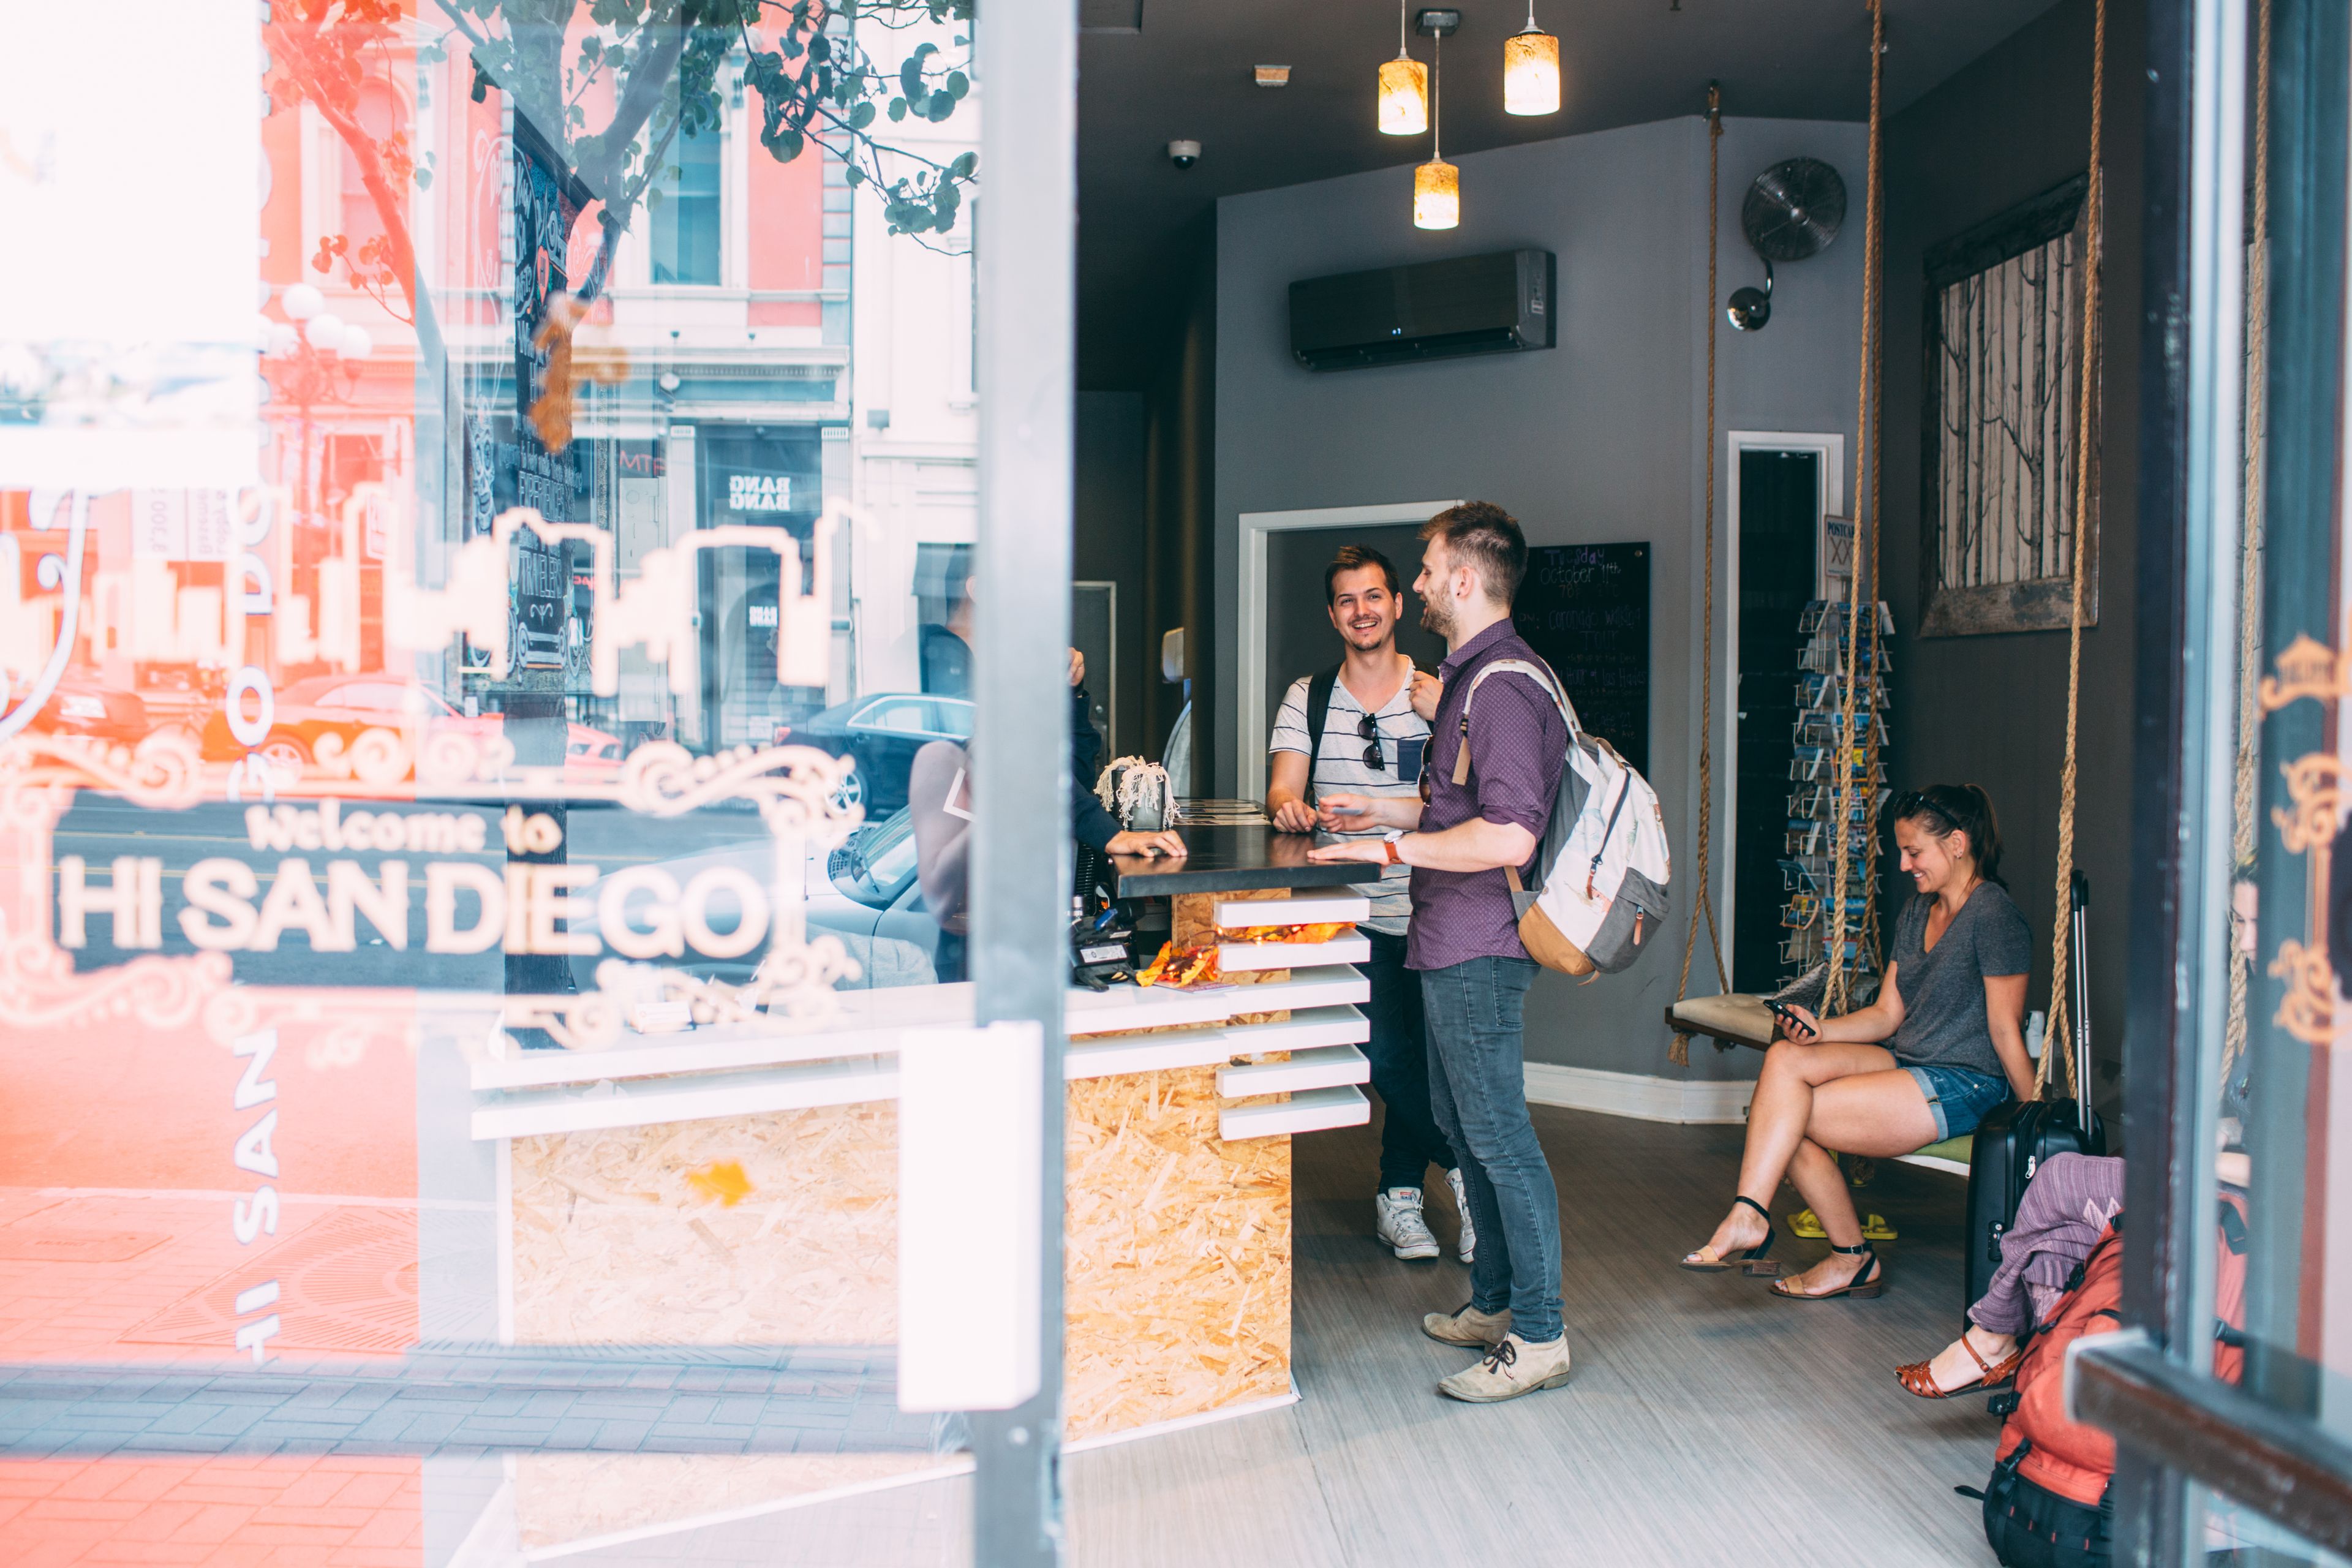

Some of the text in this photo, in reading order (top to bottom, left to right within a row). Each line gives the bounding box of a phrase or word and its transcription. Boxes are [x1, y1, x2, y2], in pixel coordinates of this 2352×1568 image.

[1544, 546, 1605, 567] Tuesday
[245, 798, 563, 856] Welcome to
[59, 856, 771, 959] HI SAN DIEGO
[233, 1029, 280, 1246] SAN
